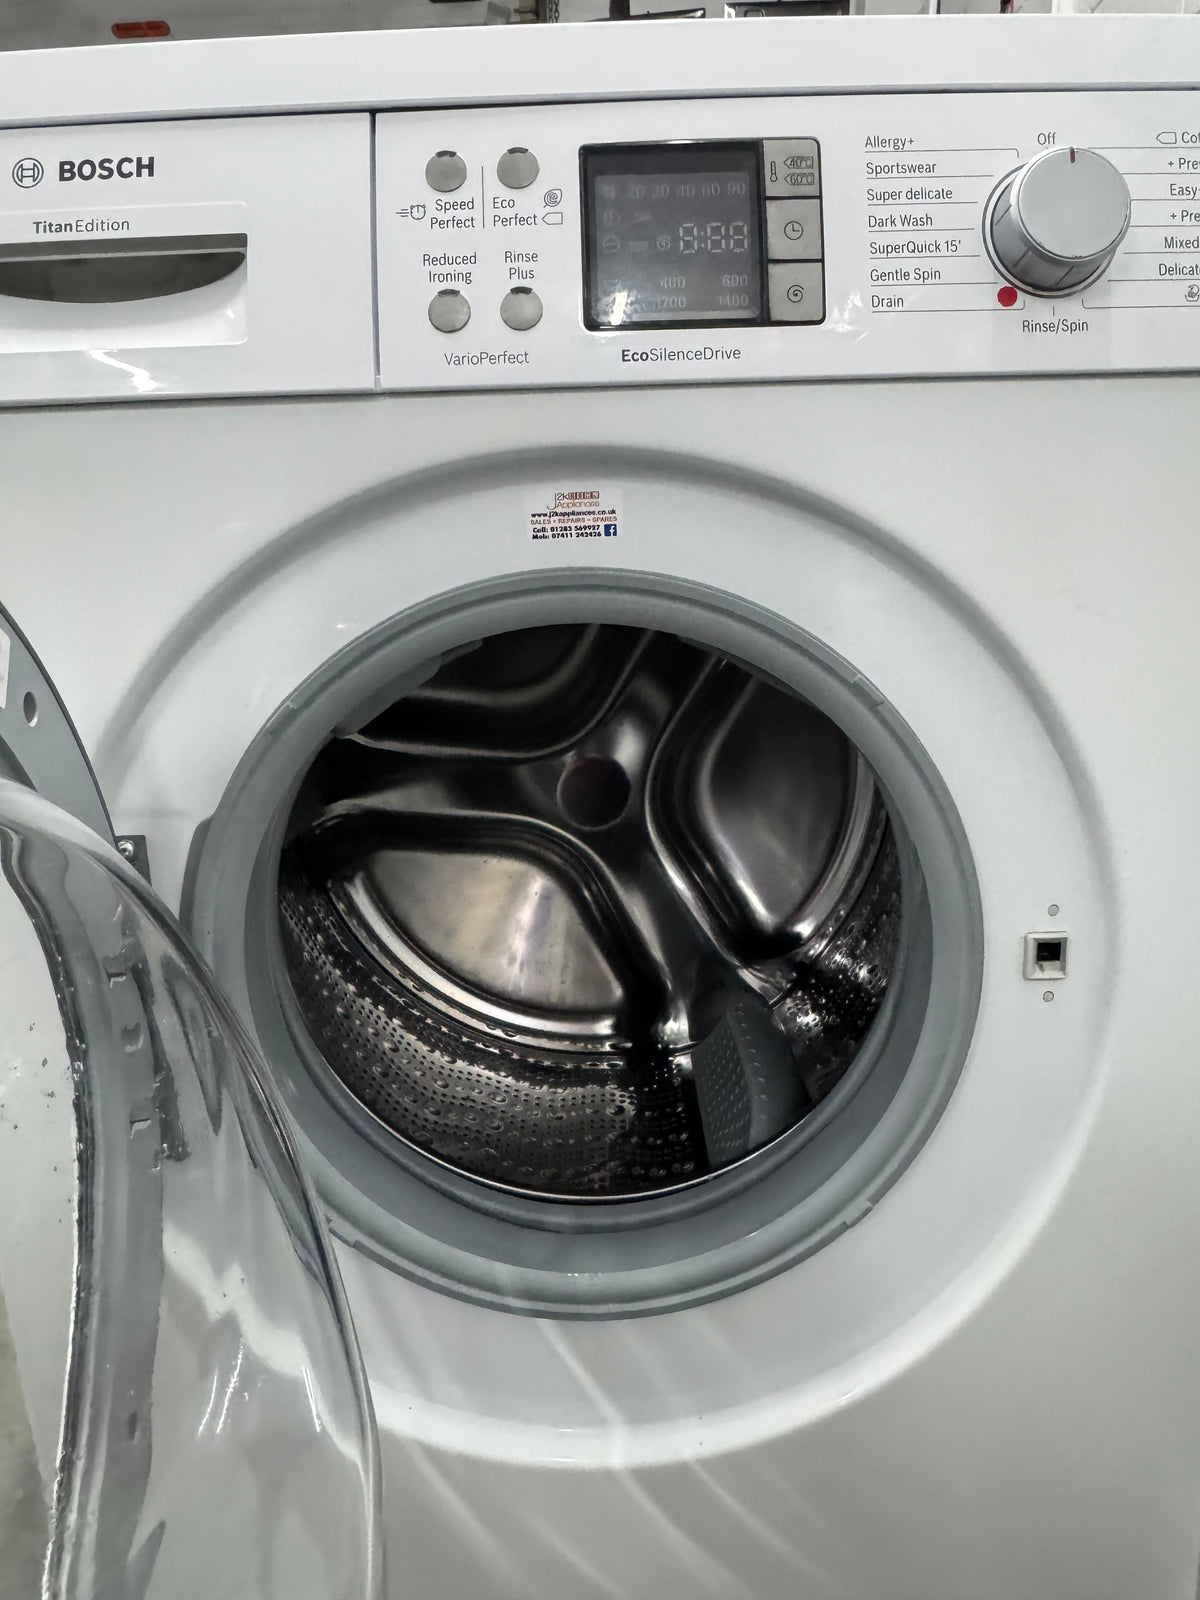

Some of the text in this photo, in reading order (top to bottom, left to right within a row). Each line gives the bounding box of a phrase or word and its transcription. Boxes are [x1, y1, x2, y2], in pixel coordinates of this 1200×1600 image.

[864, 135, 914, 150] Allergy+
[1037, 132, 1056, 145] Off
[58, 156, 155, 182] BOSCH
[866, 162, 937, 177] Sportswear
[1178, 157, 1200, 170] Pre
[866, 187, 953, 203] Super delicate
[435, 197, 475, 213] Speed
[493, 197, 515, 209] Eco
[430, 215, 476, 230] Perfect
[493, 213, 538, 227] Perfect
[868, 213, 933, 228] Dark Wash
[869, 240, 941, 257] SuperQuick
[1164, 235, 1200, 249] Mixed
[423, 252, 477, 267] Reduced
[504, 250, 539, 263] Rinse
[428, 269, 473, 284] Ironing
[509, 266, 535, 280] Plus
[870, 267, 941, 283] Gentle Spin
[871, 294, 904, 308] Drain
[1022, 318, 1089, 334] Rinse/Spin
[444, 350, 530, 366] VarioPerfect
[621, 346, 742, 363] EcoSilenceDrive
[530, 509, 617, 519] www.j2kappliances.co.uk
[550, 525, 573, 533] 01283
